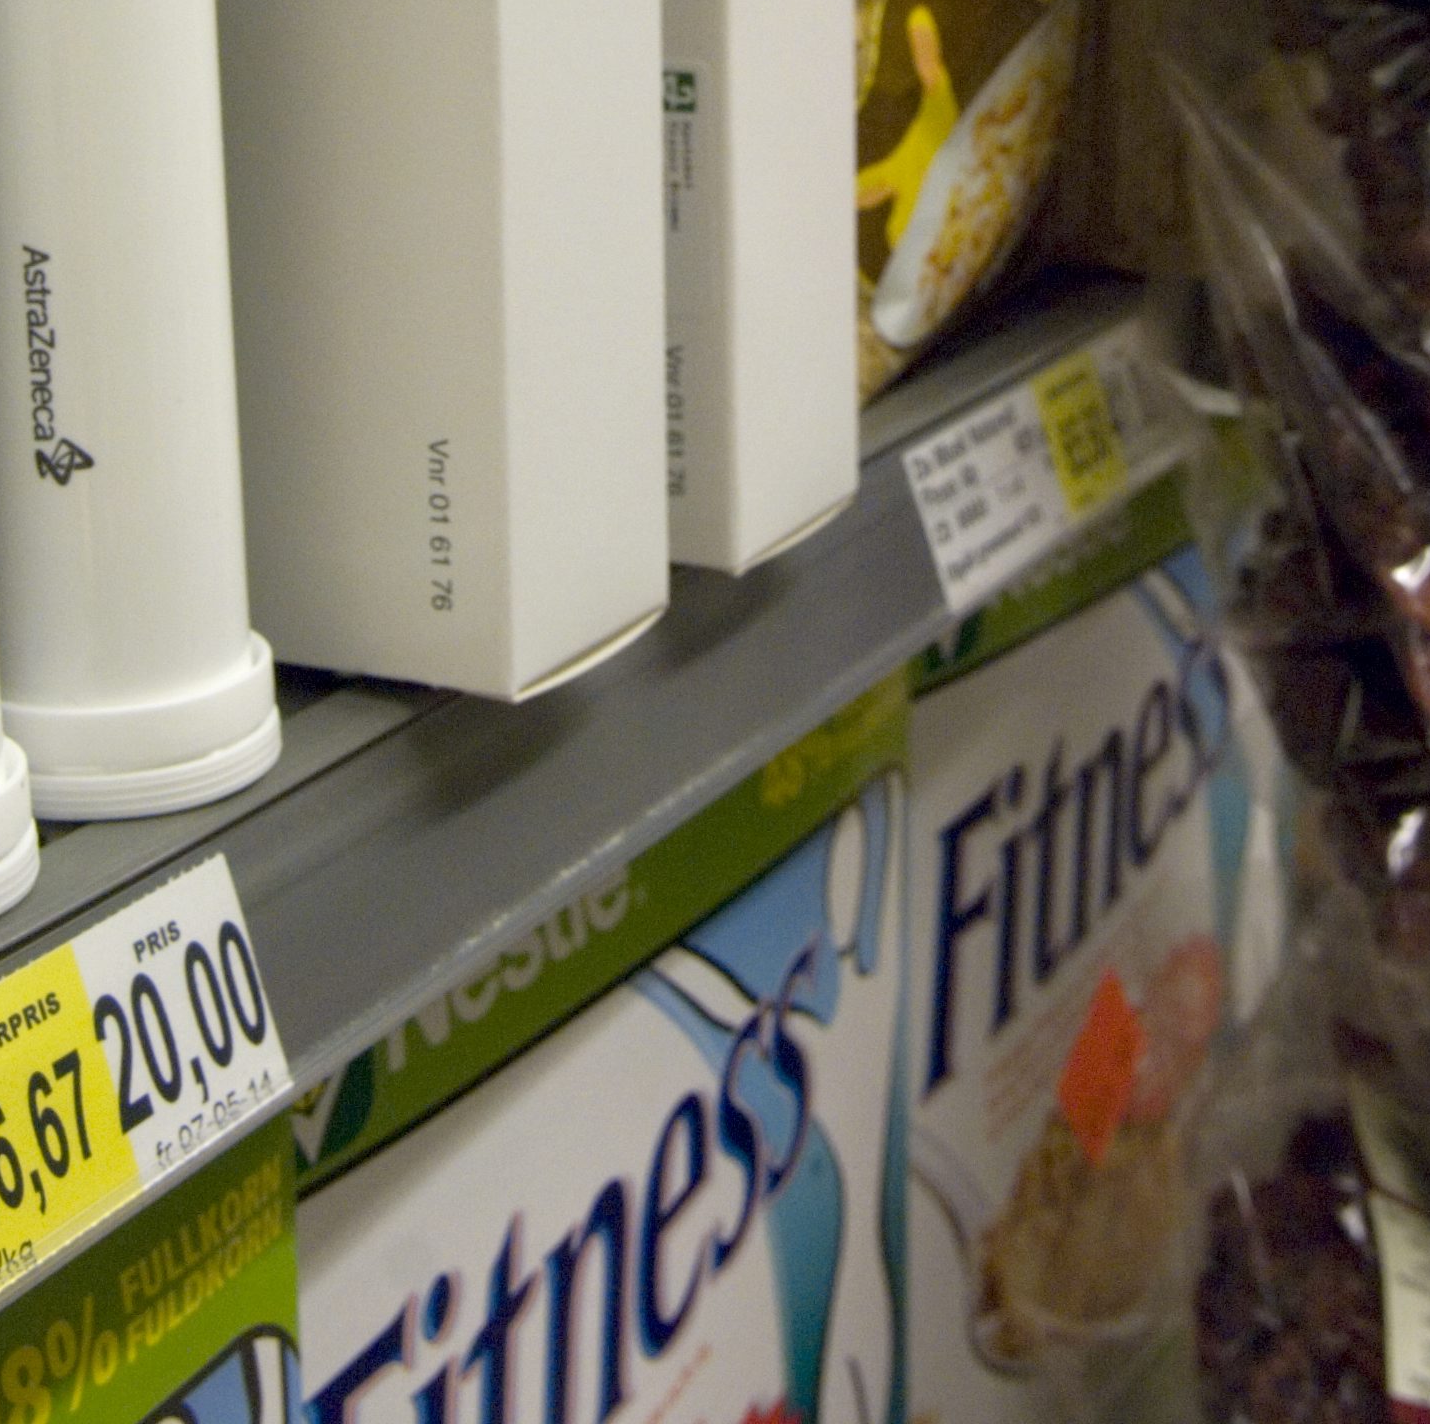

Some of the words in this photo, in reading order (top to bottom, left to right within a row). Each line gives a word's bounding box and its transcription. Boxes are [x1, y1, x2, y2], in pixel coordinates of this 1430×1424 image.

[23, 244, 55, 443] AstraZeneca
[428, 438, 449, 489] Vnr
[429, 493, 451, 527] 01
[429, 535, 451, 567] 61
[431, 578, 453, 612] 76
[133, 921, 181, 963] PRIS
[93, 921, 267, 1136] 20,00
[302, 932, 821, 1424] tness
[122, 1153, 282, 1314] FULLKORN
